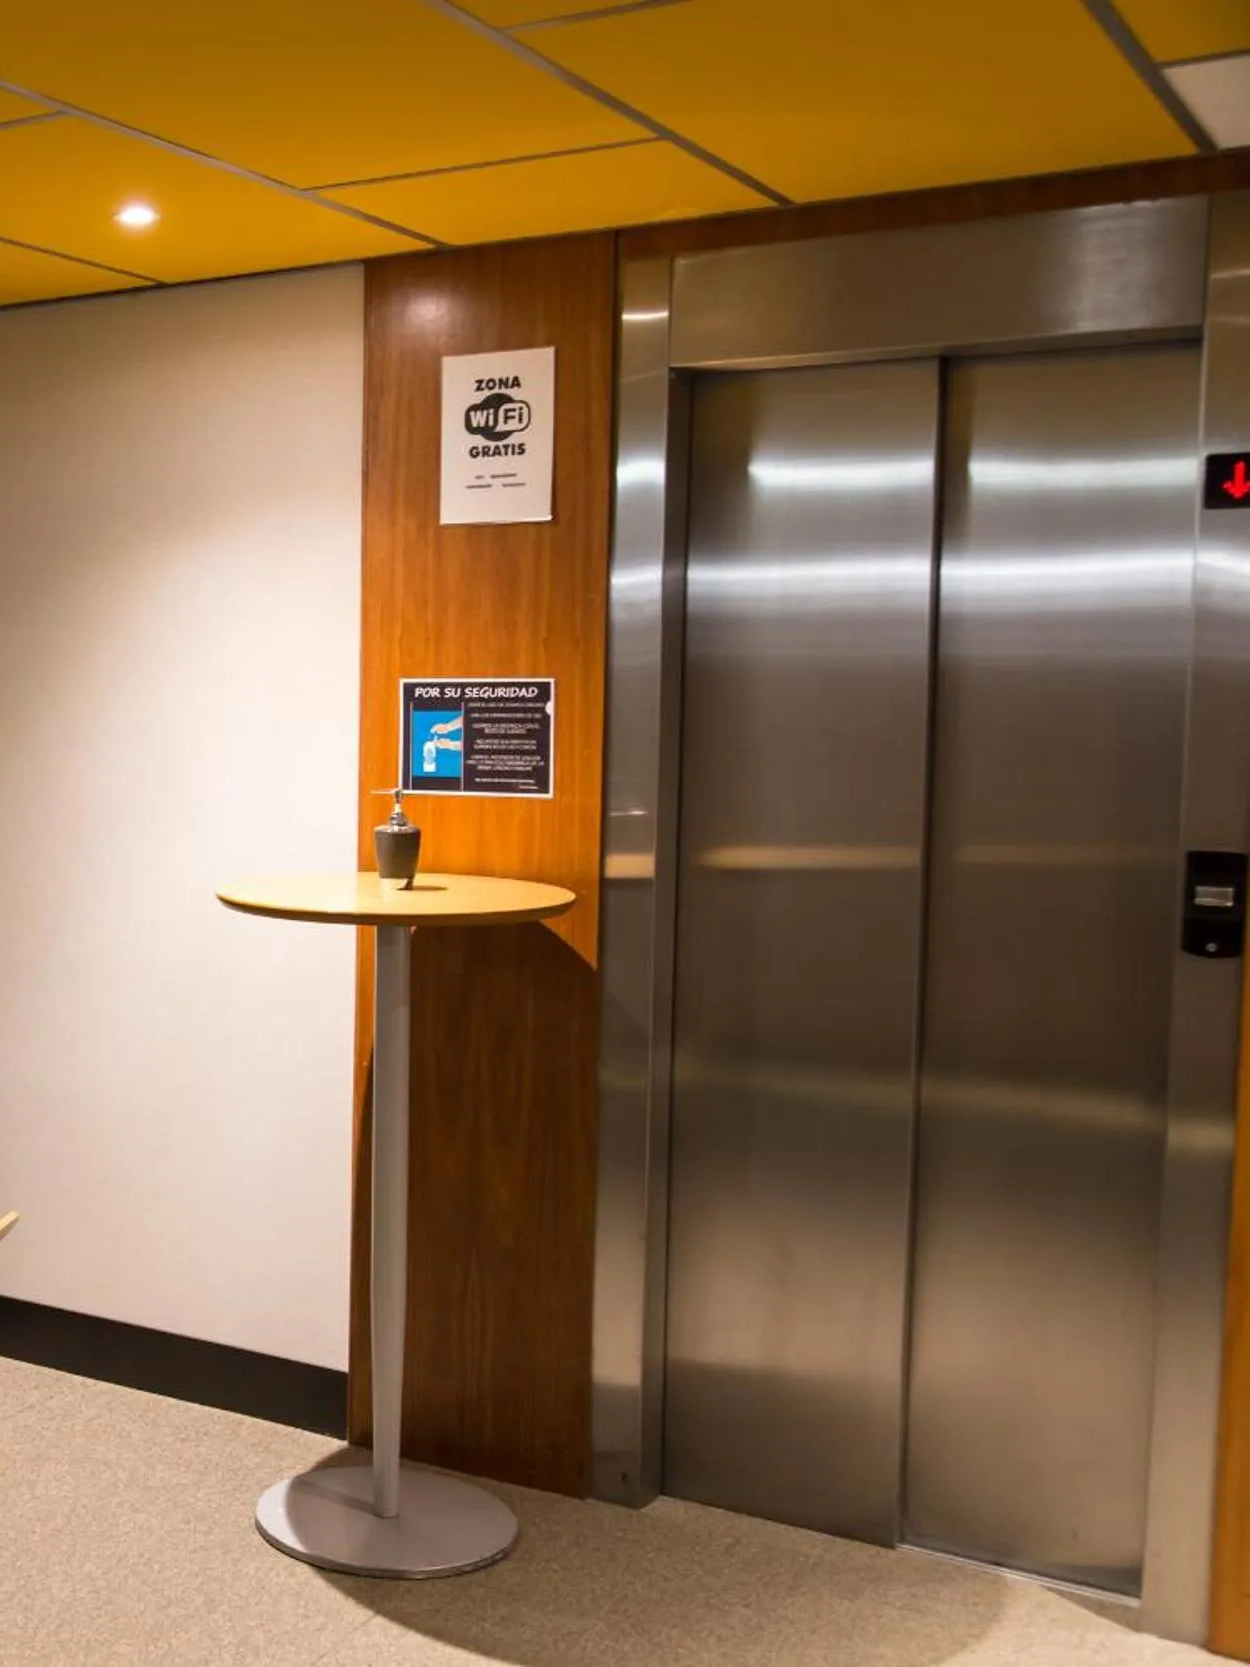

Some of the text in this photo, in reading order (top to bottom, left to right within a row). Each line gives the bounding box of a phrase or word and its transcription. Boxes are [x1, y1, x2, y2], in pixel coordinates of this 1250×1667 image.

[474, 376, 522, 392] ZONA
[468, 443, 526, 459] GRATIS
[414, 686, 538, 699] POR SU SEGURIDAD
